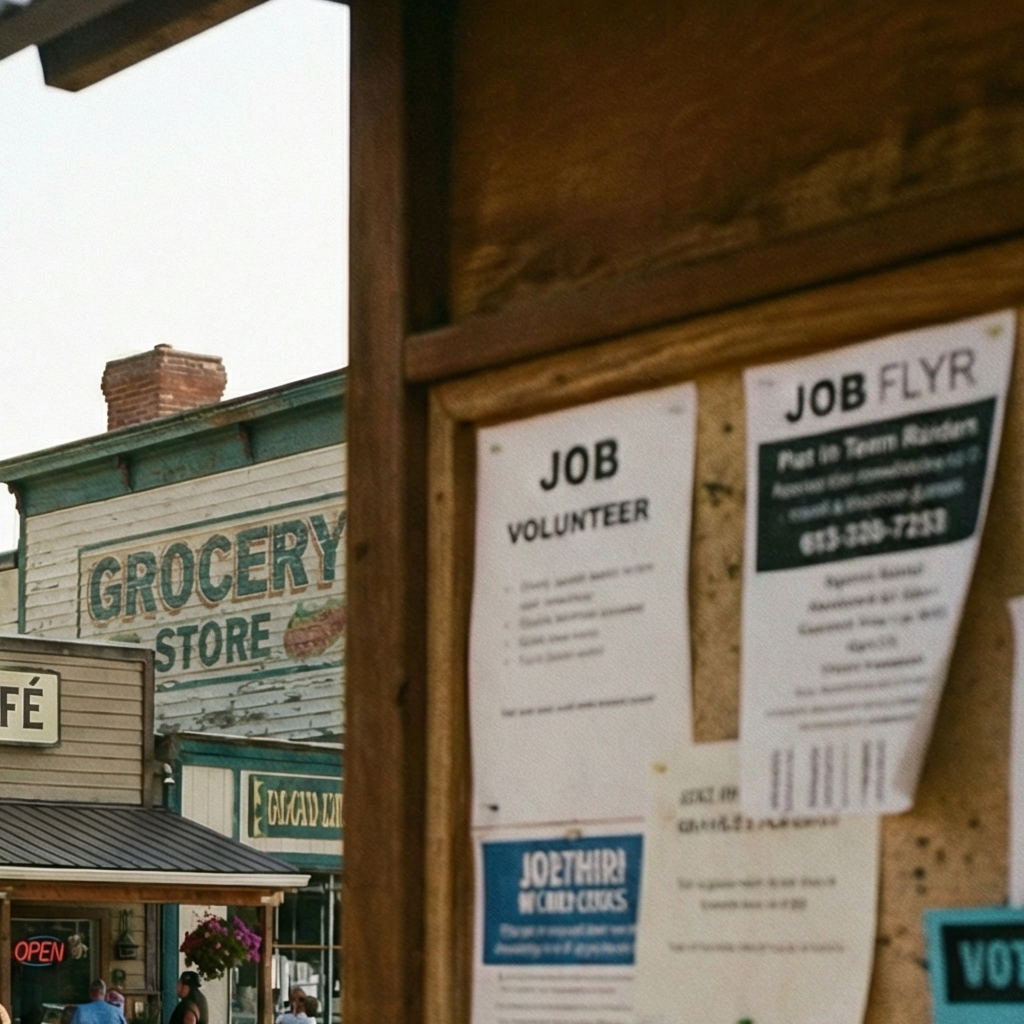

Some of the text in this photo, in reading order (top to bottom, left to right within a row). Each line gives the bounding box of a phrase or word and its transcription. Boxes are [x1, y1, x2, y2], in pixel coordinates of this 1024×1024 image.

[785, 349, 976, 422] JOB FLYR
[540, 438, 618, 490] JOB
[507, 498, 649, 543] VOLUNTEER
[89, 509, 345, 625] GROCERY
[156, 612, 271, 672] STORE
[14, 941, 65, 963] OPEN
